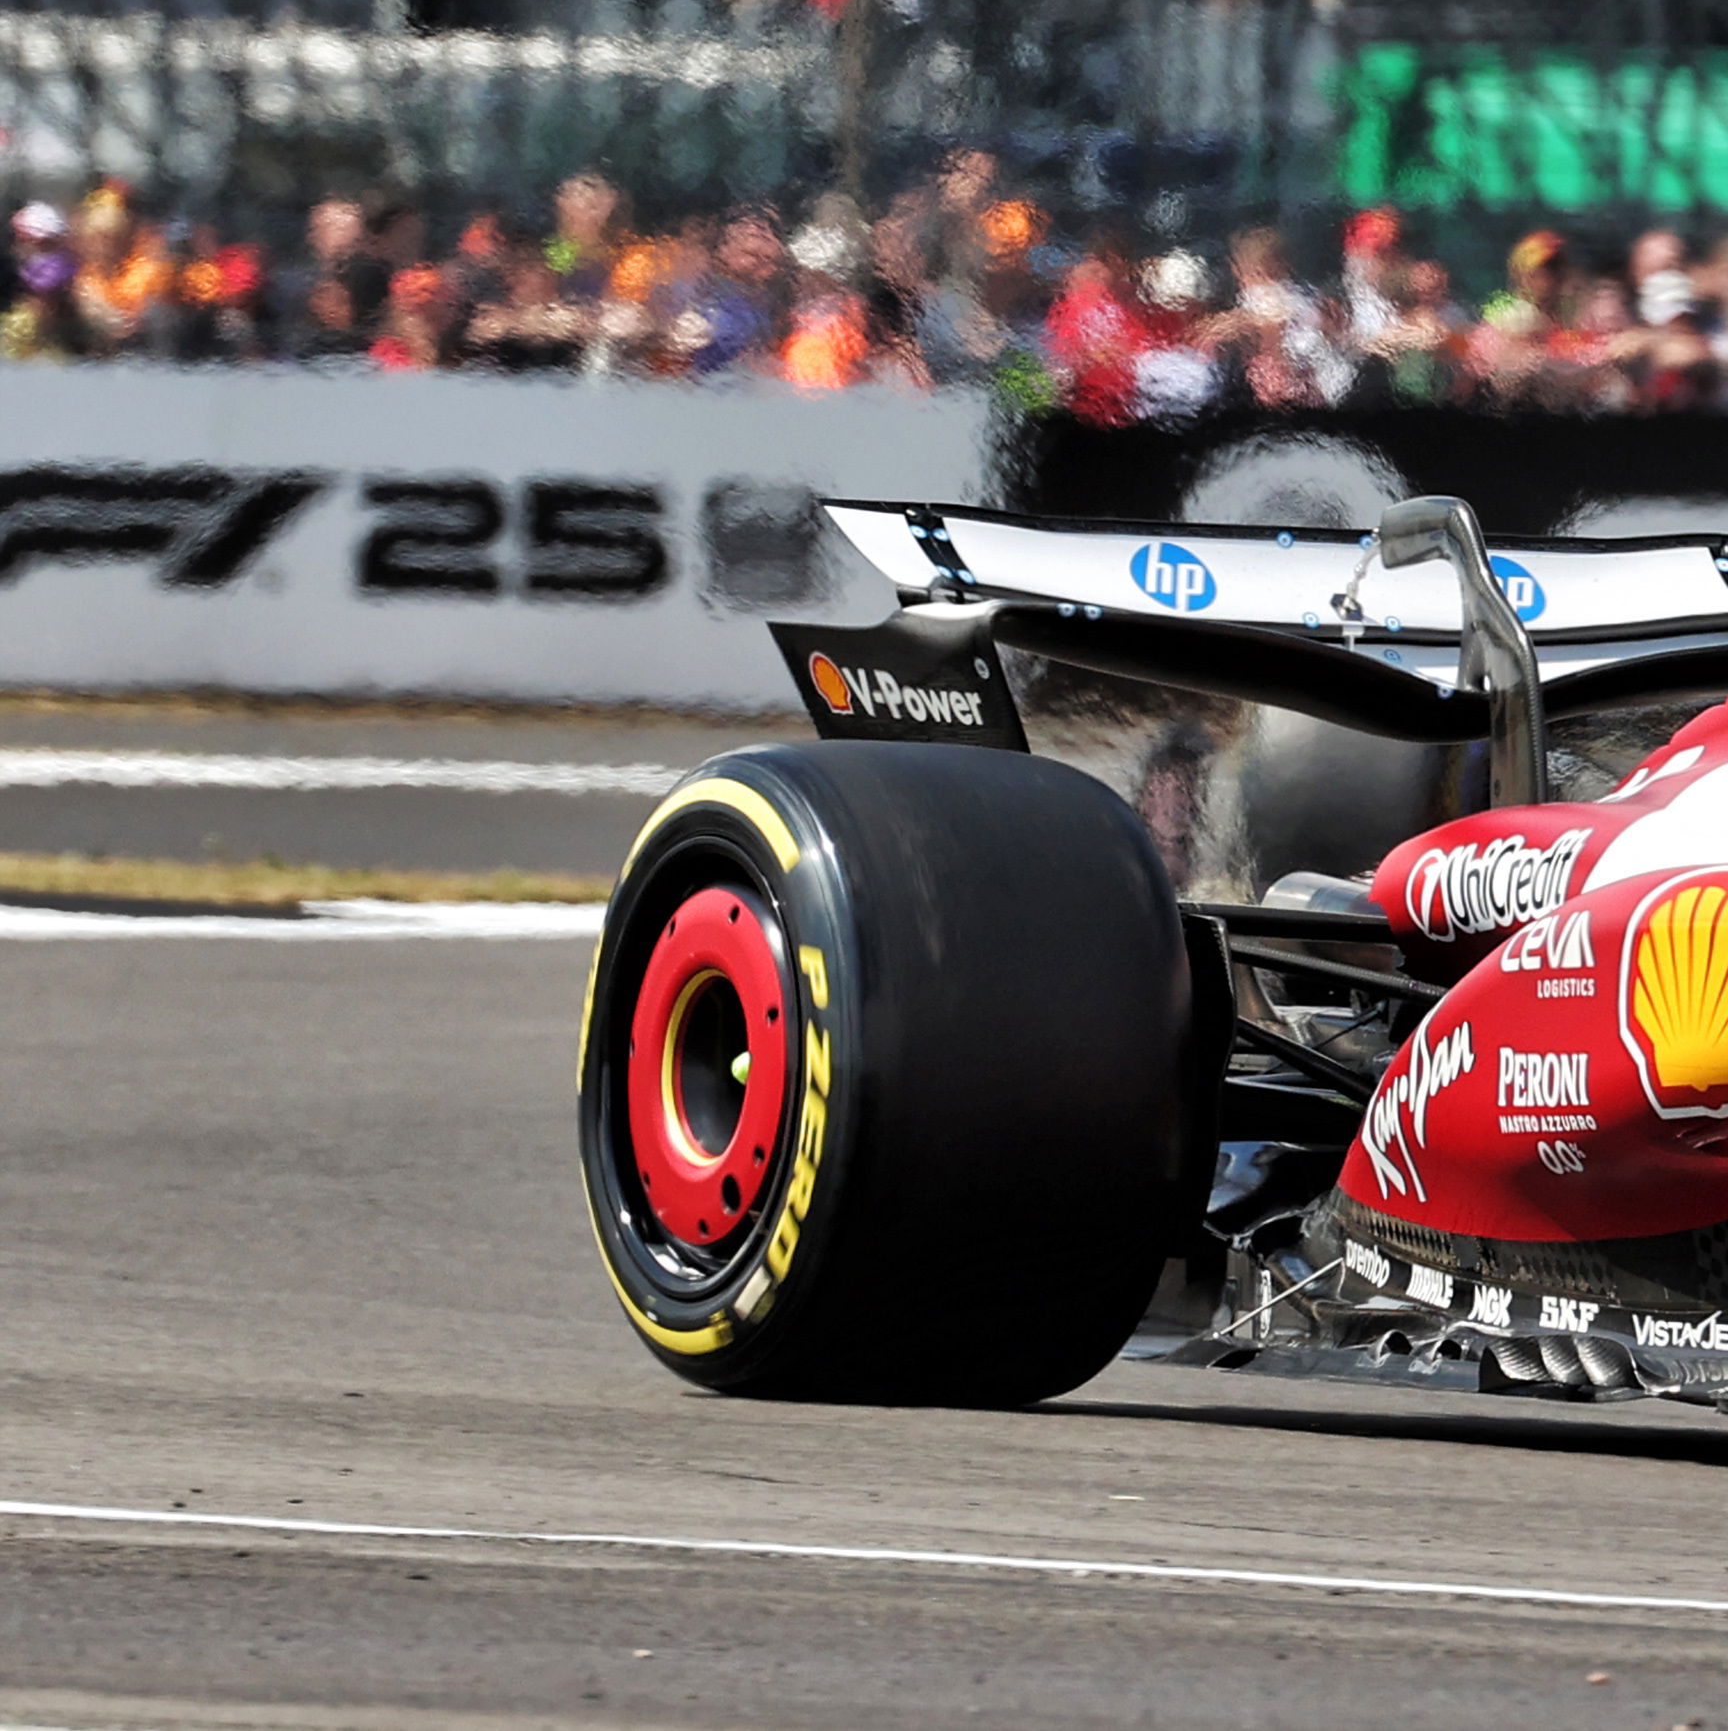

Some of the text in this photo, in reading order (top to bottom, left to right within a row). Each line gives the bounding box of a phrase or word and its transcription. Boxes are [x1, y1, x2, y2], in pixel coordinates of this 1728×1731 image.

[357, 477, 670, 598] 25
[1145, 541, 1205, 612] hp
[846, 666, 983, 726] V-Power
[1447, 828, 1594, 935] UniCredit
[1536, 978, 1596, 999] LOGISTICS
[1496, 1046, 1590, 1109] PERONI
[767, 944, 831, 1283] P ZERO
[1499, 1114, 1598, 1135] NASTRO AZZURRO
[1405, 1263, 1455, 1310] MAHLE
[1467, 1284, 1513, 1328] NGK
[1539, 1295, 1600, 1333] SKF
